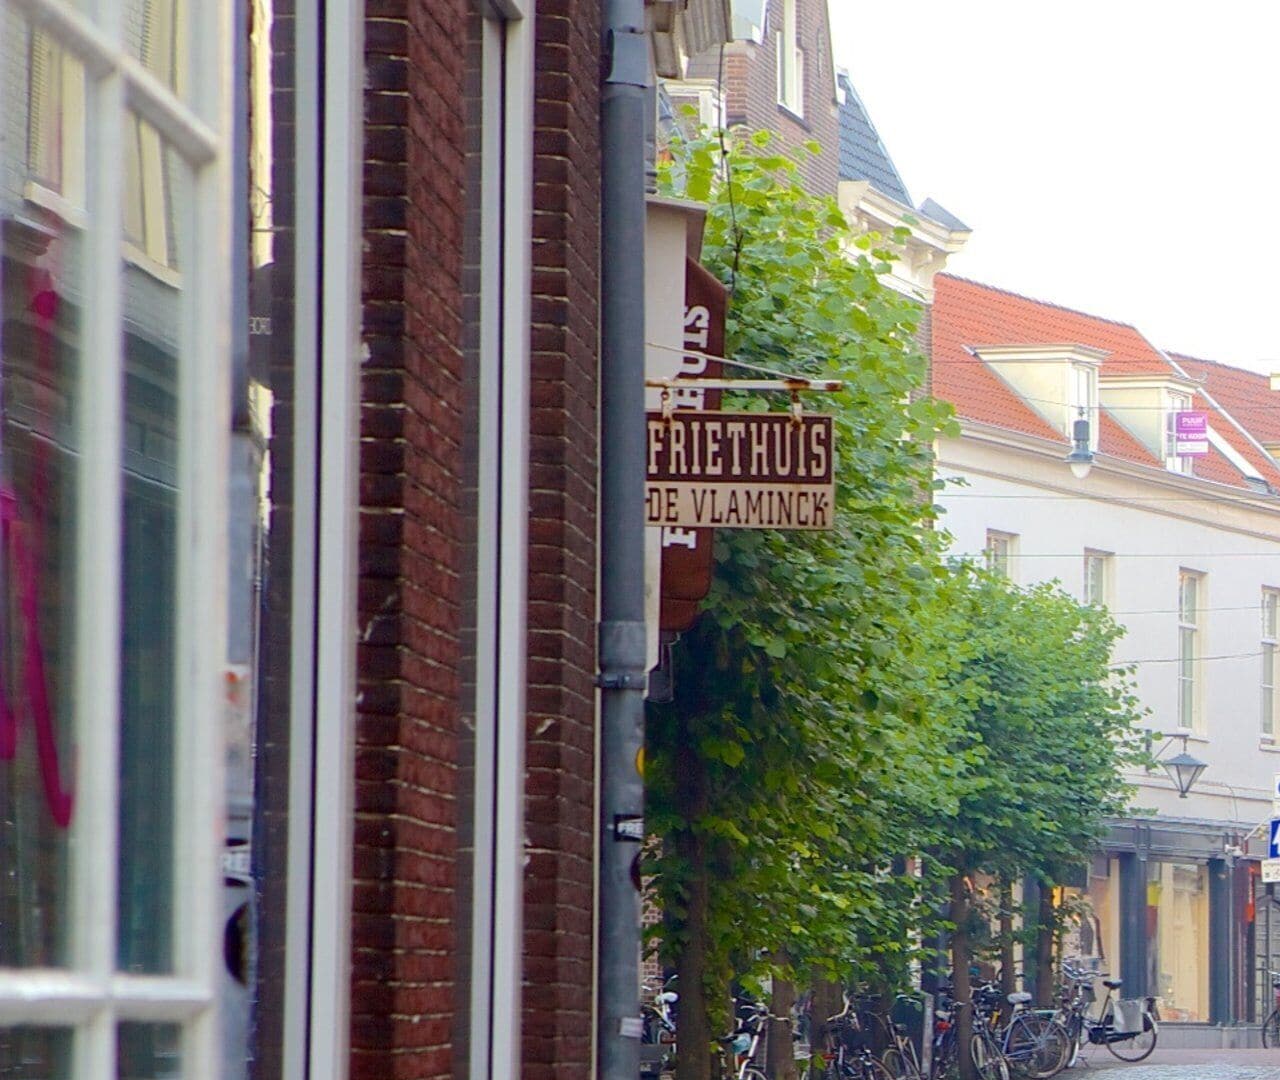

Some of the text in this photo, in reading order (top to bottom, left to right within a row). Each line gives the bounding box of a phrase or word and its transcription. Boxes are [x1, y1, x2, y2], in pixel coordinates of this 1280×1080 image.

[648, 421, 827, 478] FRIETHUIS
[648, 488, 828, 527] DE VLAMINCK
